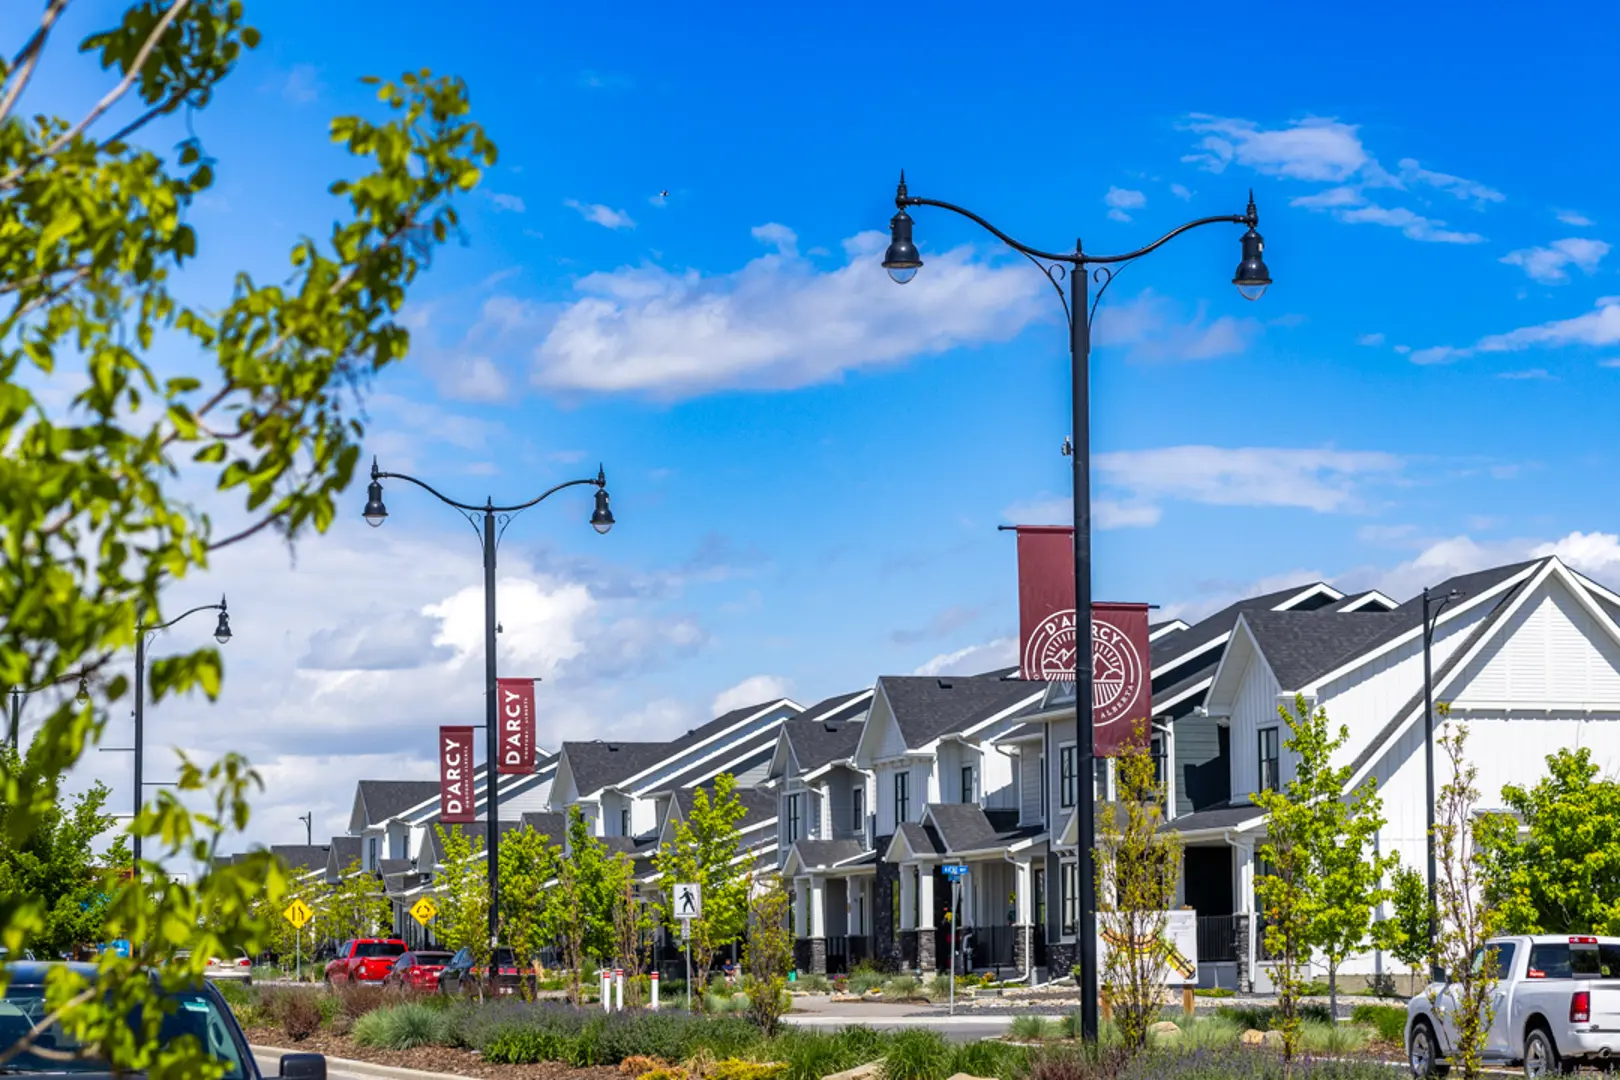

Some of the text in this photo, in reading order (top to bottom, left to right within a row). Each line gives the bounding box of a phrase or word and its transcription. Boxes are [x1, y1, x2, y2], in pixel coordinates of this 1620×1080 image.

[505, 690, 521, 765] D'ARCY
[1101, 684, 1134, 719] ALBERTA
[445, 738, 462, 814] D'ARCY
